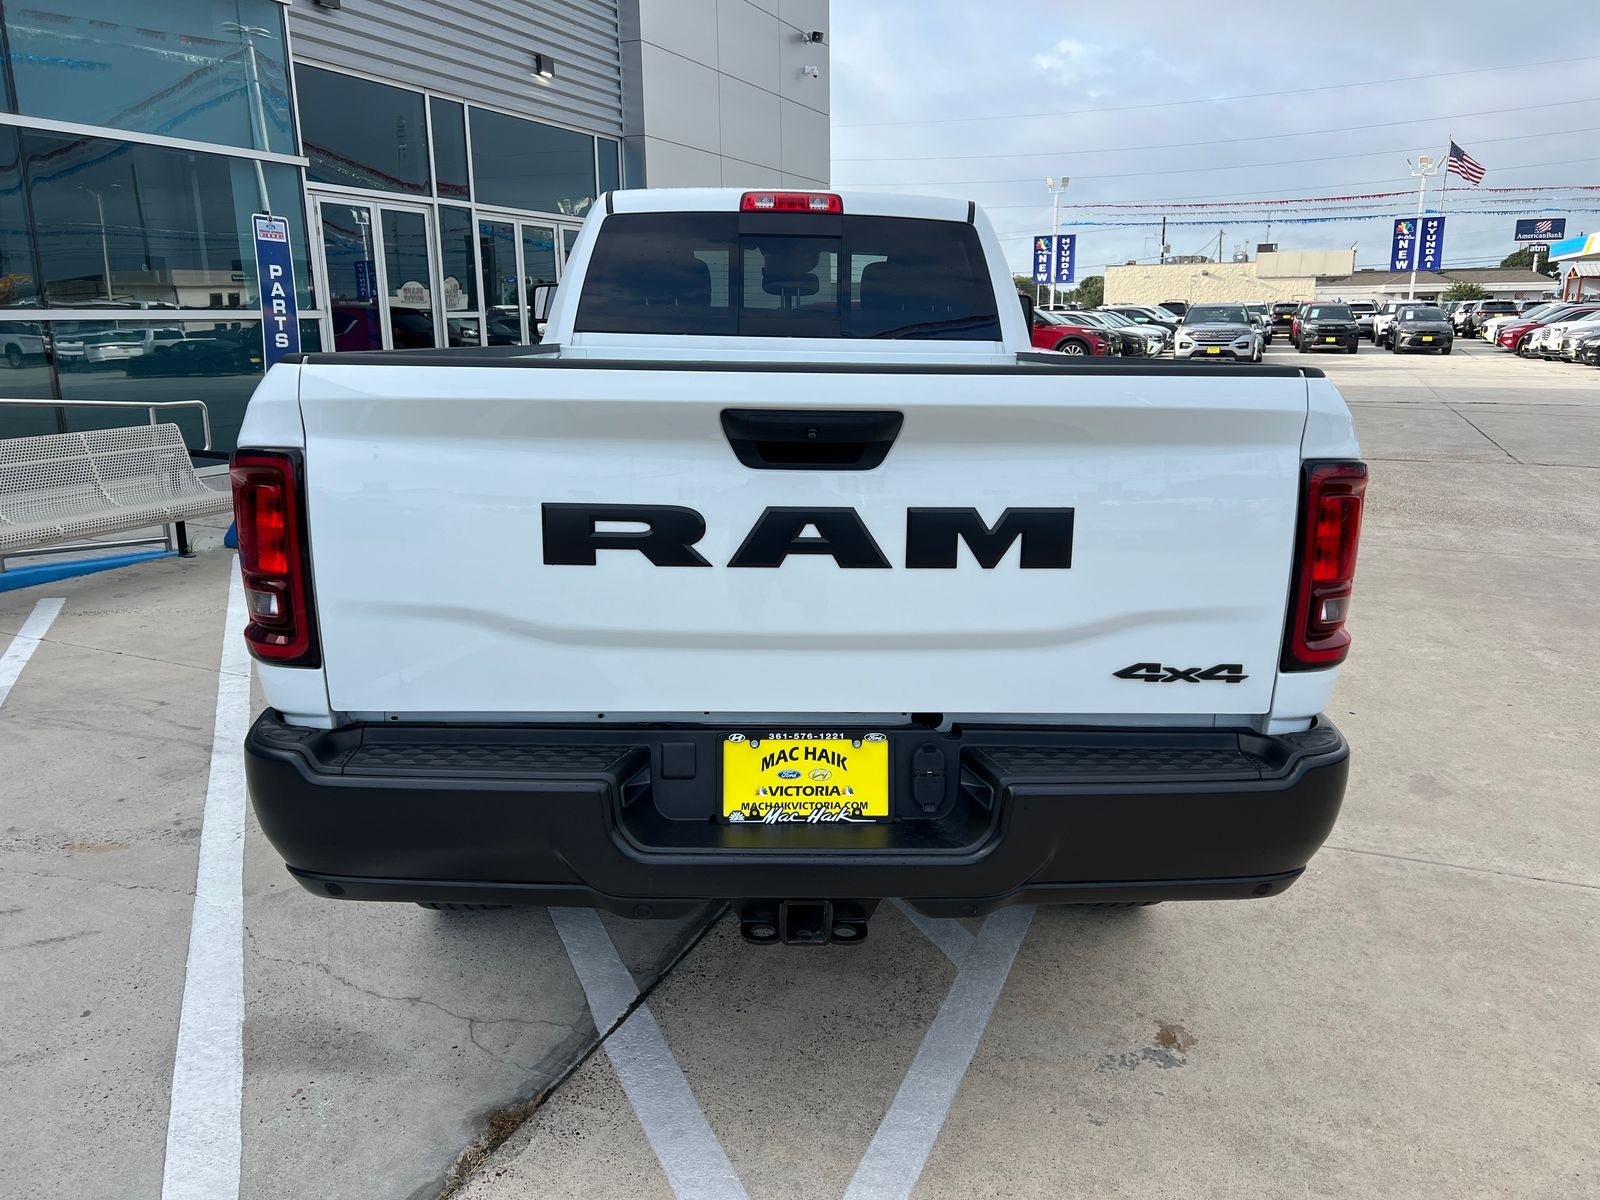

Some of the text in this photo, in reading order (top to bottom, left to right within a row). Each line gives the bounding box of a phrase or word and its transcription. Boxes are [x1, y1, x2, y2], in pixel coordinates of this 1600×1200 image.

[1395, 239, 1409, 270] NEW
[1424, 221, 1438, 268] HYUNDAI
[1529, 244, 1547, 252] atm
[1037, 254, 1048, 282] NEW
[1060, 238, 1070, 280] HYUNDAI
[269, 264, 289, 348] PARTS
[541, 502, 1075, 569] RAM
[1112, 662, 1249, 683] 4x4
[768, 732, 845, 740] 361-576-1221
[866, 733, 885, 742] Ford
[761, 746, 848, 772] MAC HAIK
[780, 770, 798, 779] Ford
[768, 785, 841, 797] VICTORIA
[740, 801, 869, 811] MACHAIKVICTORIA.COM
[763, 806, 852, 824] Mac Haik
